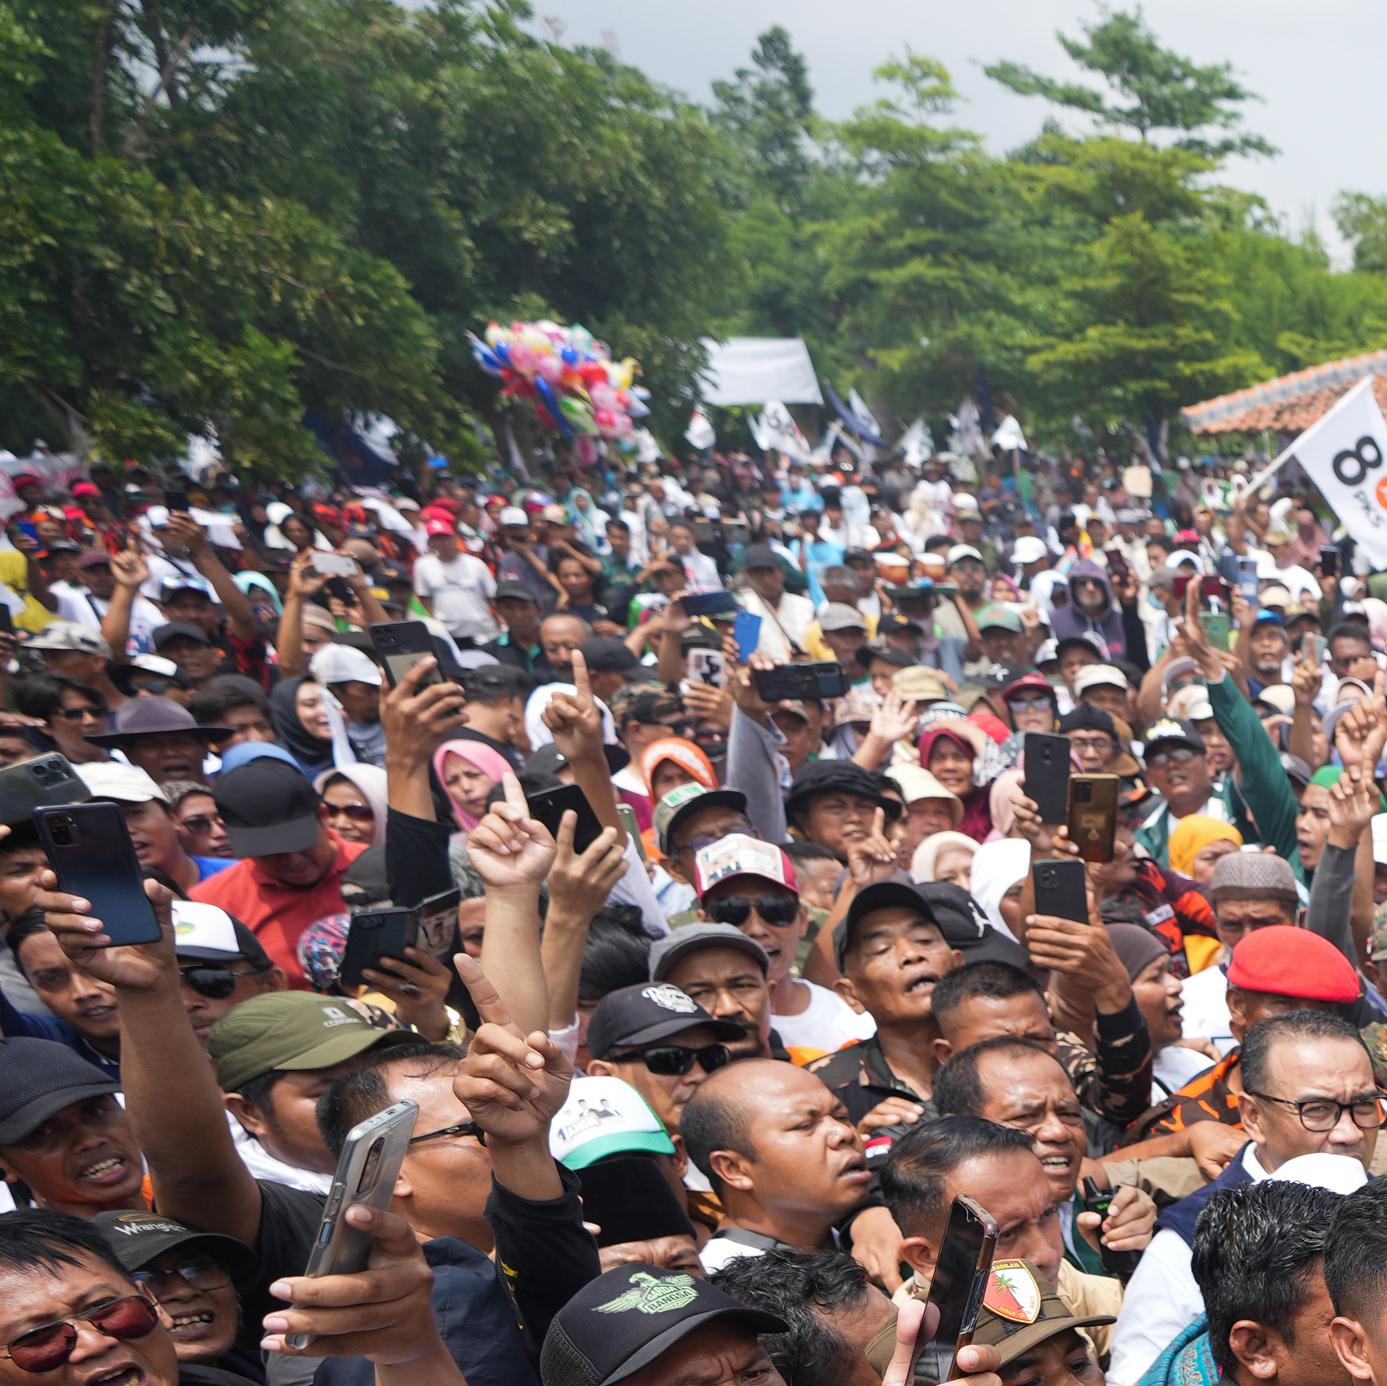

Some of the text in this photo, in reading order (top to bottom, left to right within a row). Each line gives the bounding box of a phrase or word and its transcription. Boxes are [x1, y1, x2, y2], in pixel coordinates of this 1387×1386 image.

[1332, 436, 1382, 486] 8
[1353, 489, 1386, 529] PKS
[648, 1290, 692, 1312] BANGSA
